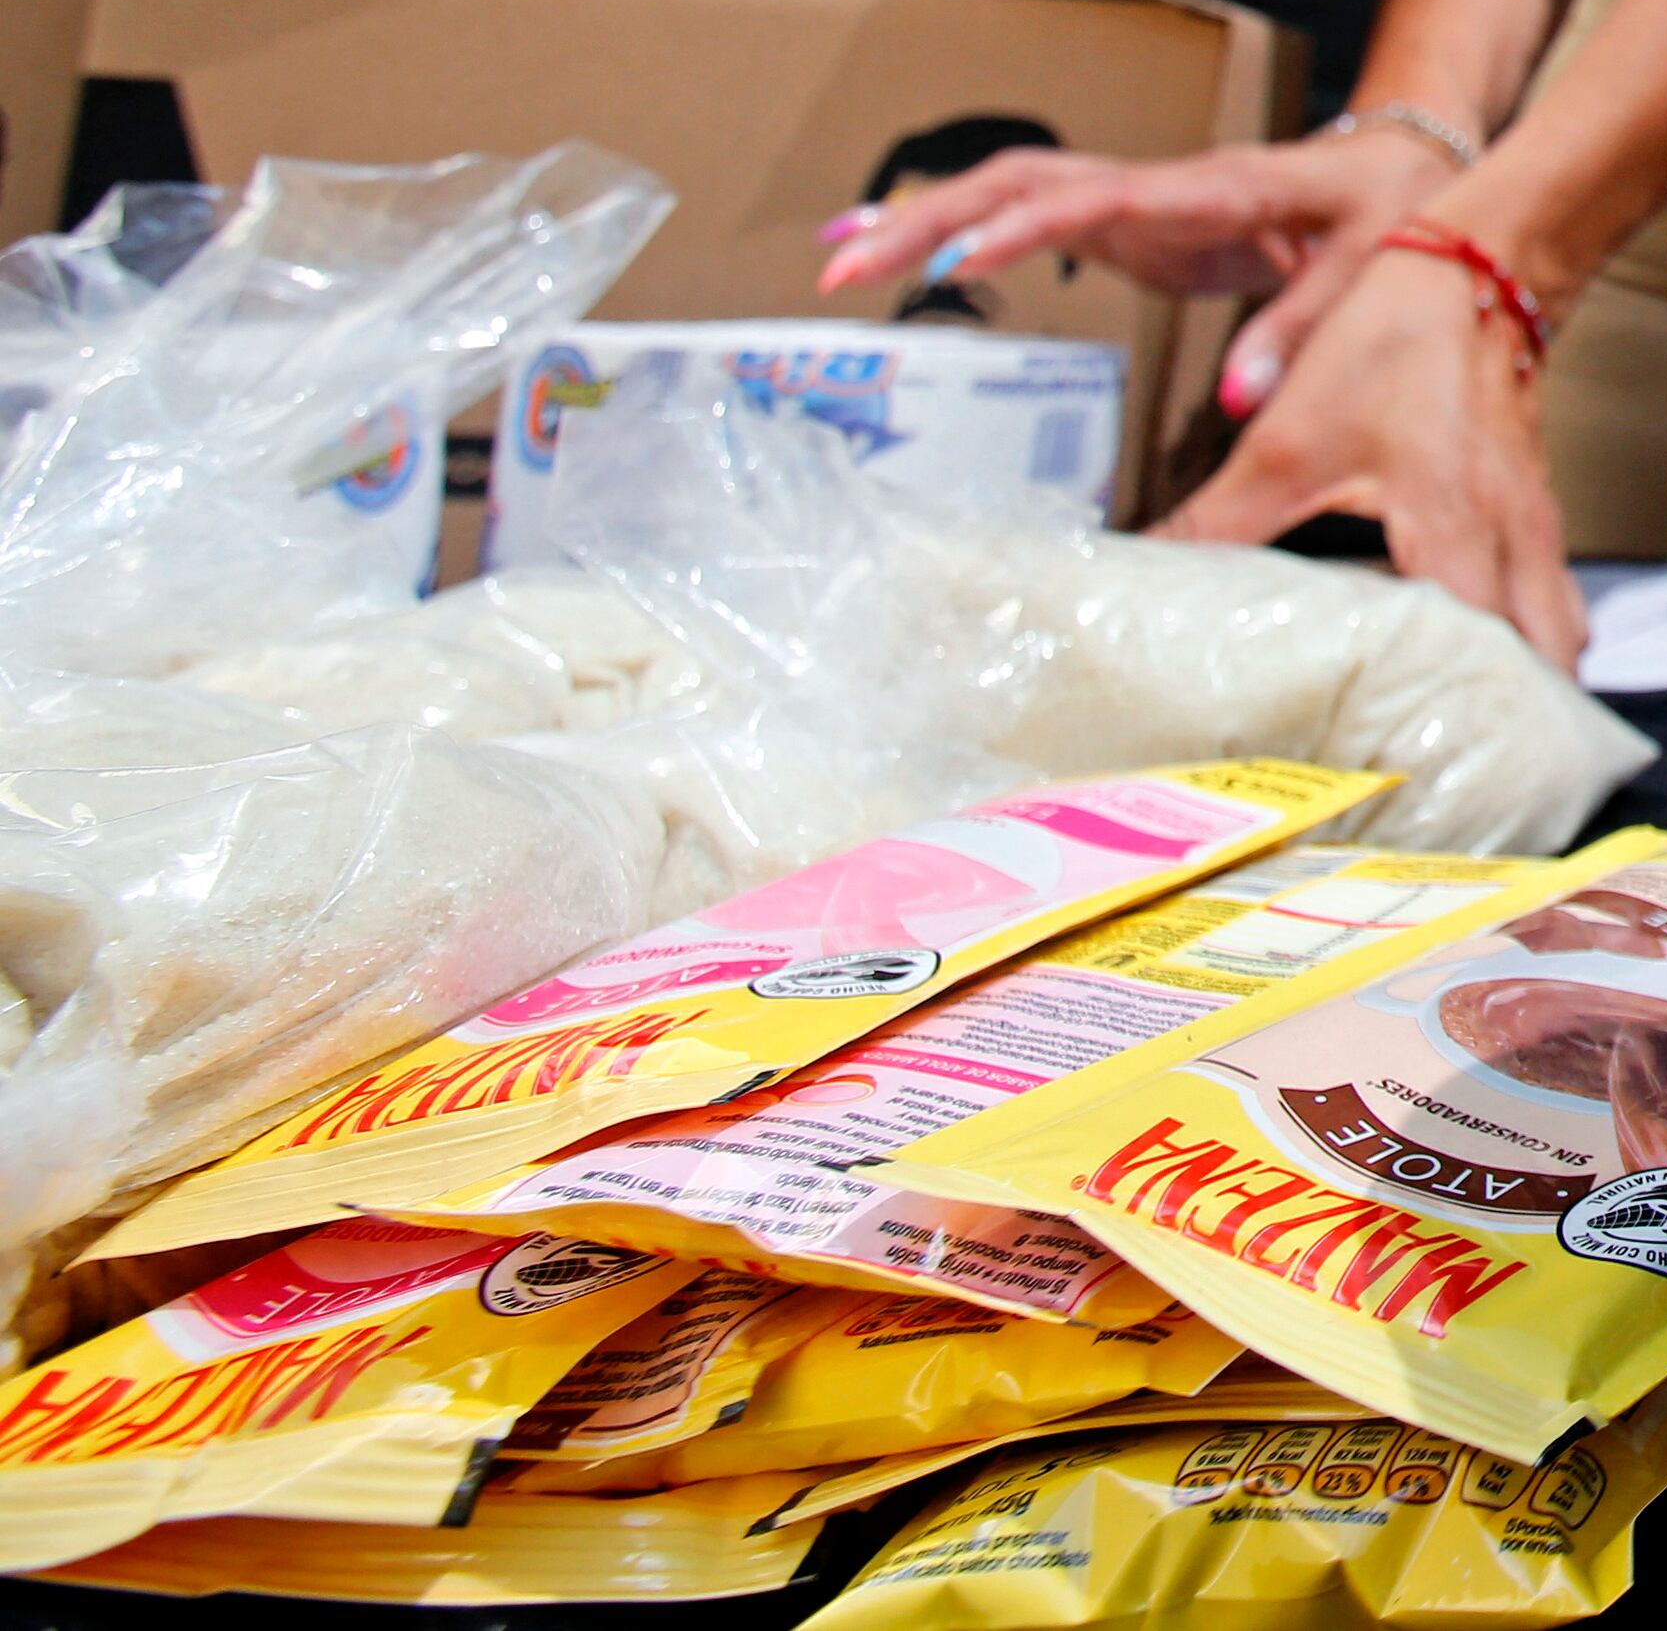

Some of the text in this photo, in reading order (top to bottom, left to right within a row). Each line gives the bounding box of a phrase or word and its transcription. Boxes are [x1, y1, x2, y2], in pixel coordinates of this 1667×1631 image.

[1326, 1120, 1525, 1200] ATOLE
[1551, 1146, 1592, 1169] SIN
[1584, 1173, 1658, 1207] NATURAL
[1084, 1119, 1528, 1339] MAIZENA
[1605, 1242, 1641, 1260] CON
[1030, 1254, 1088, 1277] Tiempo
[994, 1271, 1051, 1296] minutos
[1047, 1278, 1071, 1296] 15
[1319, 1472, 1362, 1491] 23 %
